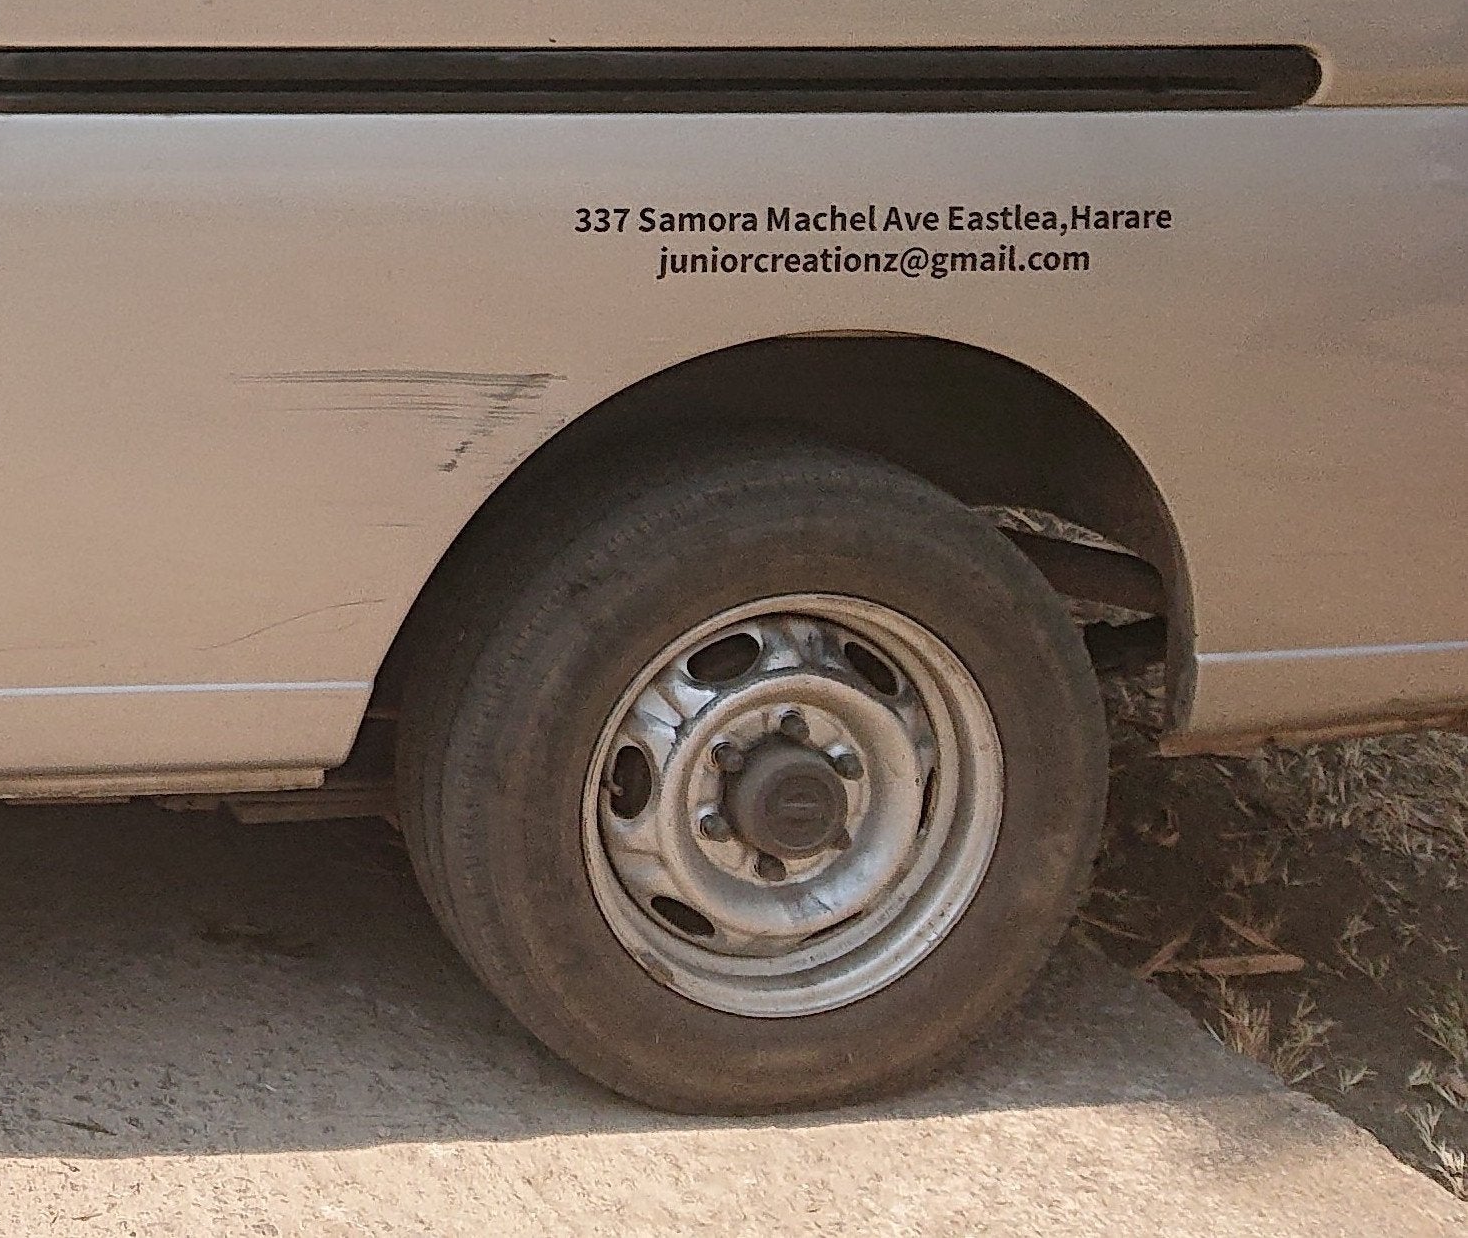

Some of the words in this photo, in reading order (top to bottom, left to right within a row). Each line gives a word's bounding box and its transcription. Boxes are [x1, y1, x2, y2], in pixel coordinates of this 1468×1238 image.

[574, 207, 630, 233] 337
[638, 206, 758, 233] Samora
[767, 204, 876, 232] Machel
[883, 206, 940, 232] Ave
[656, 244, 1091, 281] juniorcreationz@gmail.com
